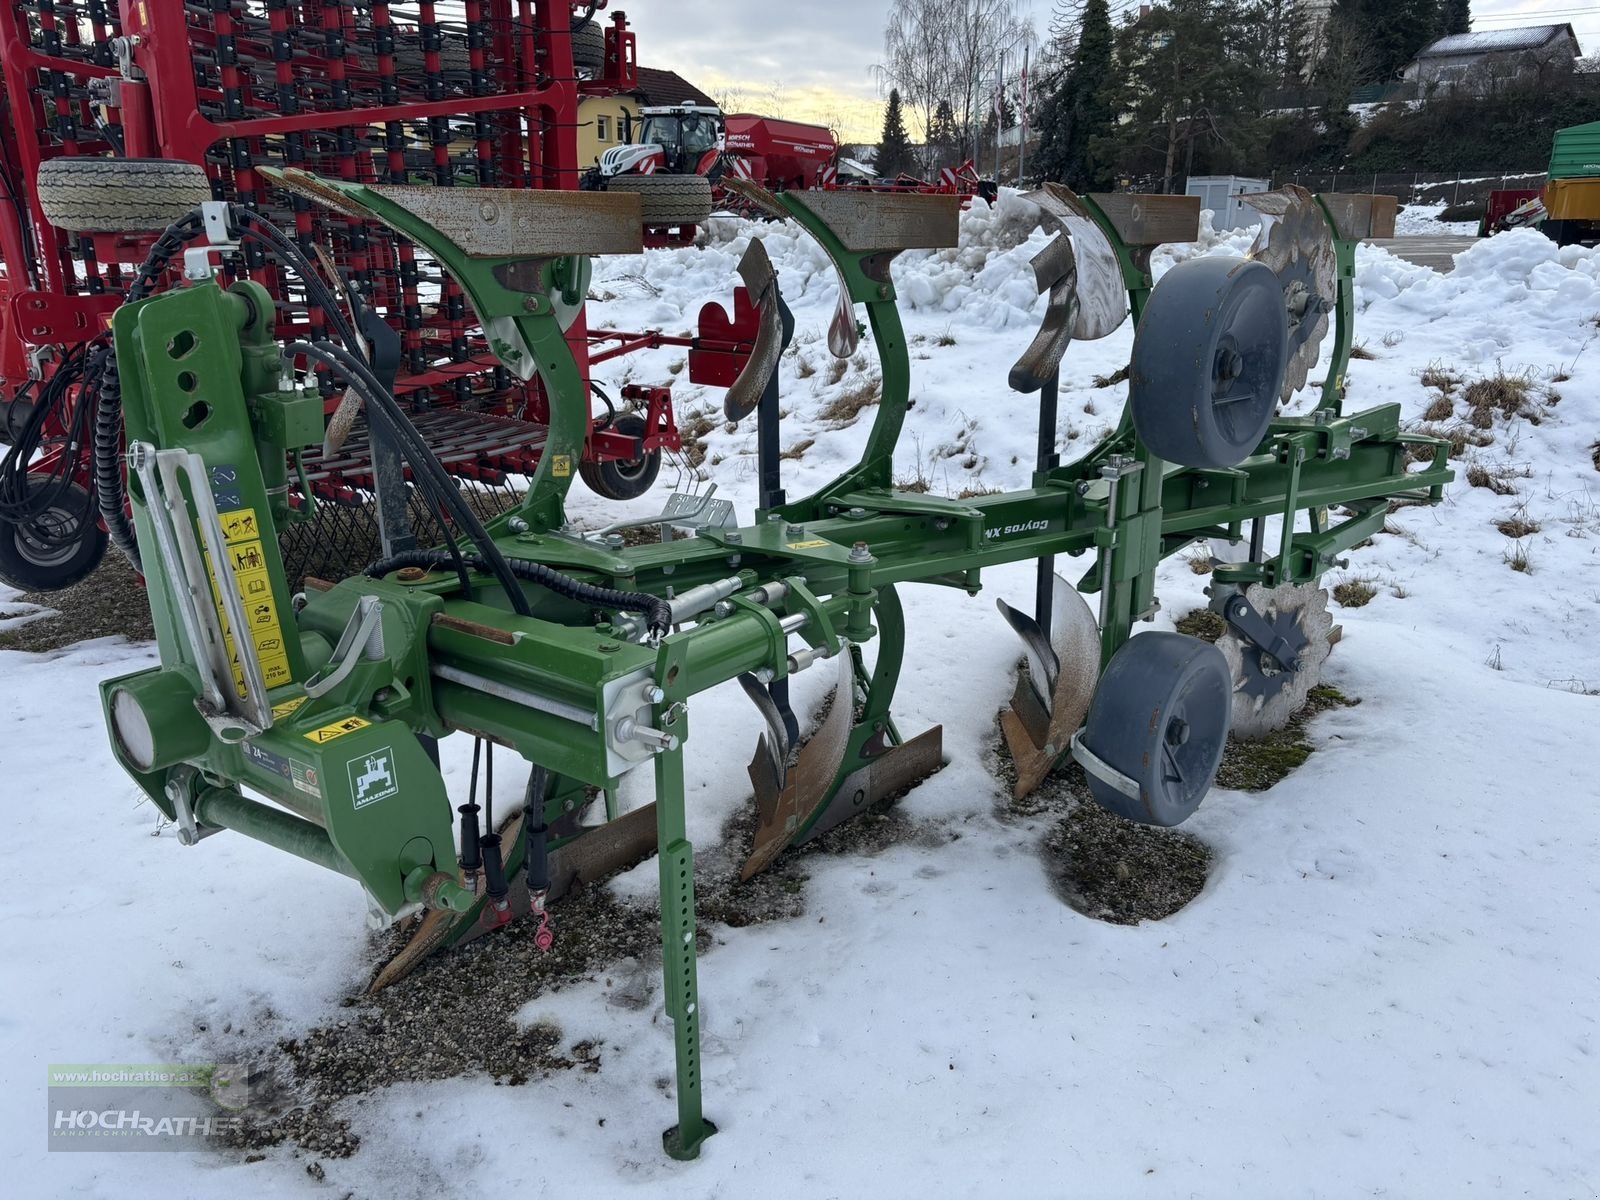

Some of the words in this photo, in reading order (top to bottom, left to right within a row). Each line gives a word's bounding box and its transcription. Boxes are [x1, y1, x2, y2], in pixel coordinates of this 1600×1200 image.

[1004, 520, 1049, 534] Cayros
[265, 672, 277, 680] 210
[277, 669, 287, 677] bar
[355, 786, 397, 807] AMAZONE
